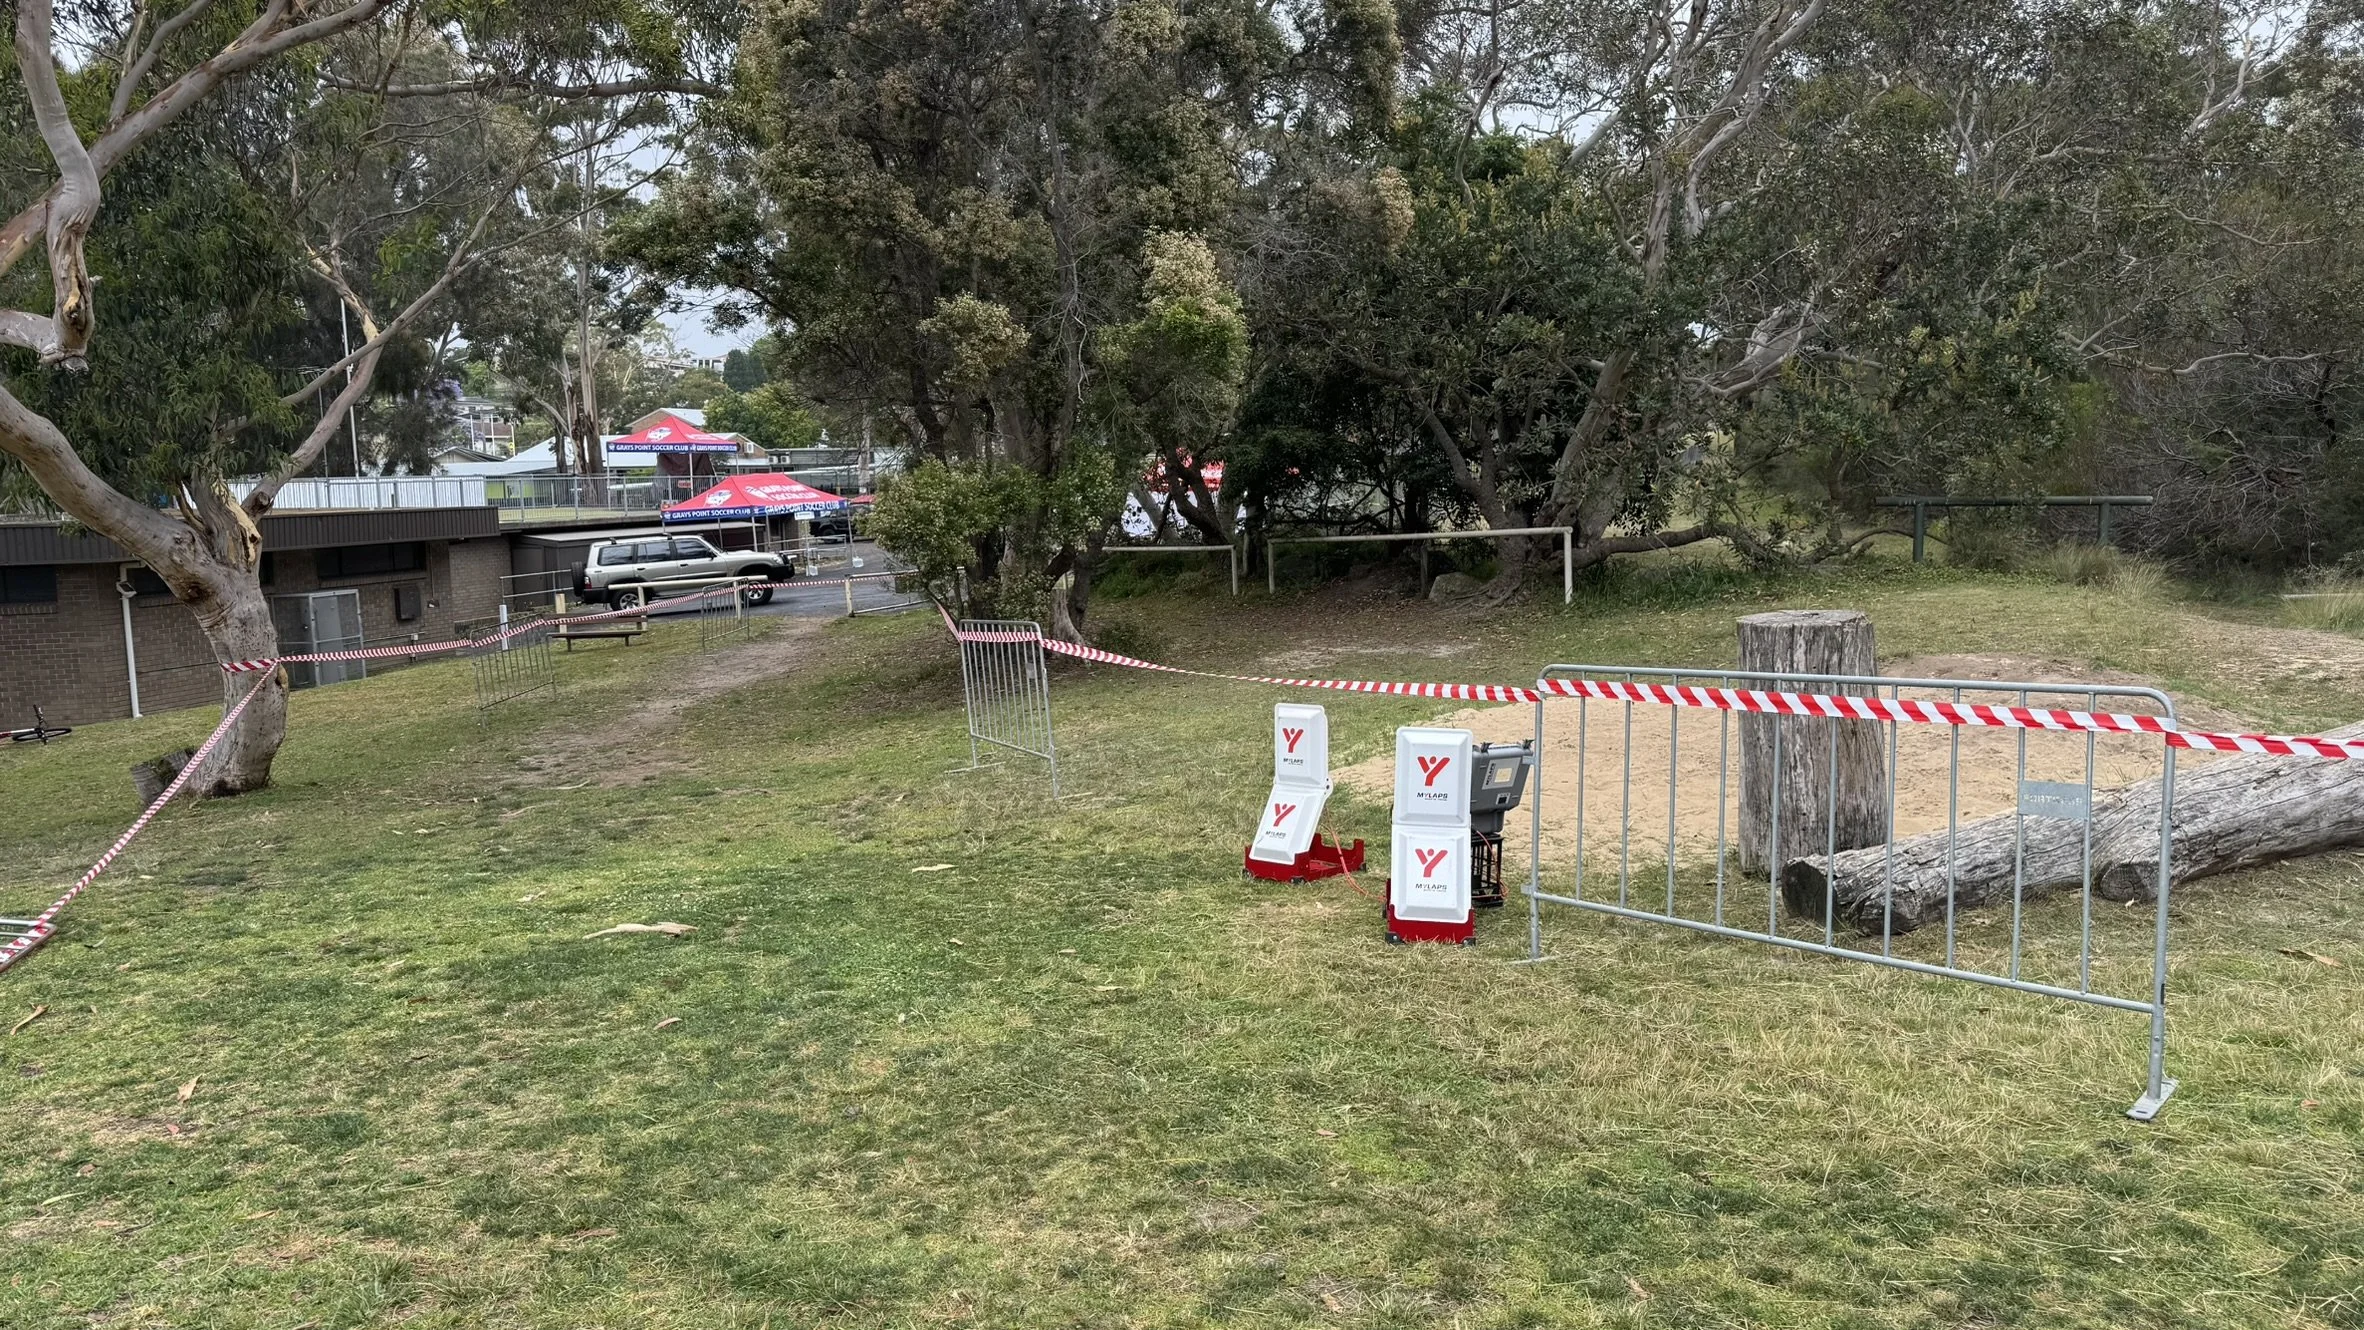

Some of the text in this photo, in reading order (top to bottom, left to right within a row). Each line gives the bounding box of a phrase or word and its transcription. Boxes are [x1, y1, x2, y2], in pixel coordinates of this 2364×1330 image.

[616, 443, 689, 451] GRAYS POINT SOCCER CLUB
[765, 504, 785, 514] GRAYS
[804, 501, 826, 511] SOCCER
[826, 500, 840, 510] CLUB
[672, 511, 692, 519] GRAYS
[692, 510, 710, 518] POINT
[711, 508, 734, 516] SOCCER
[1416, 791, 1448, 799] MYLAPS
